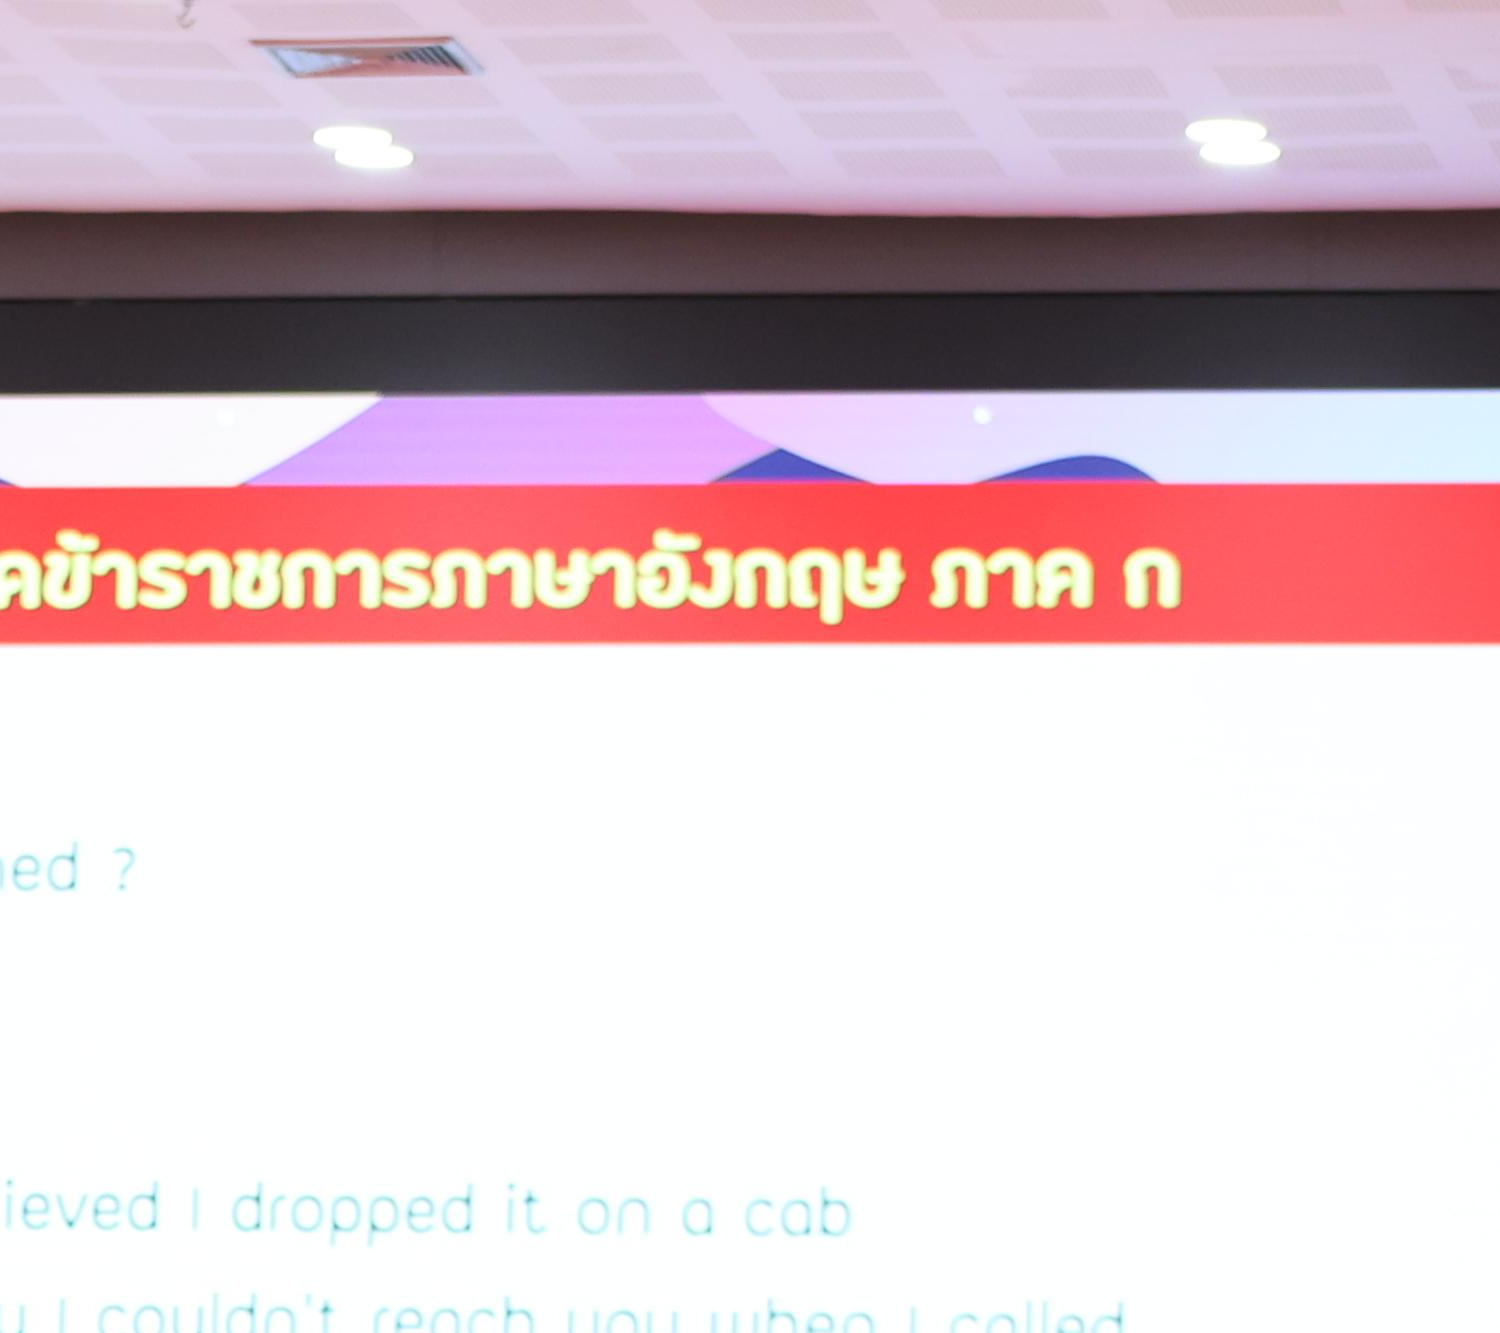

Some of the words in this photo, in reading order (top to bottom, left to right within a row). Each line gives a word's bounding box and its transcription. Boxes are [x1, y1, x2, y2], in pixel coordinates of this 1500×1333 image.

[930, 545, 1094, 609] ภาค
[1124, 545, 1181, 609] ก
[112, 845, 138, 893] ?
[230, 1181, 475, 1249] dropped
[506, 1181, 548, 1236] it
[576, 1195, 652, 1237] on
[681, 1196, 715, 1238] a
[743, 1185, 853, 1239] cab
